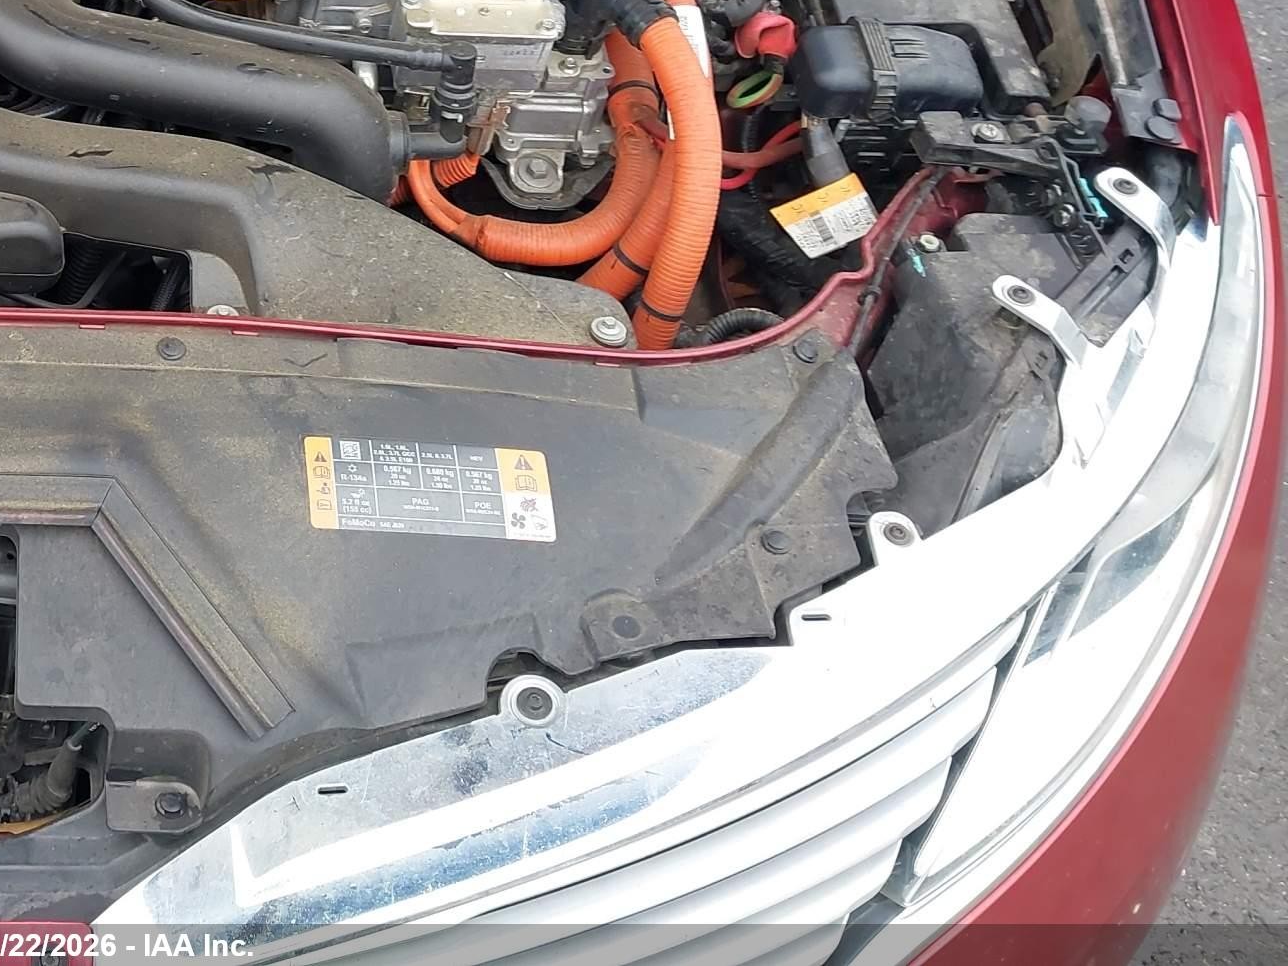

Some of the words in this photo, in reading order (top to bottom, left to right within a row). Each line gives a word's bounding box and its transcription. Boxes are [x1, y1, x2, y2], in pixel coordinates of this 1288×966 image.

[340, 473, 368, 482] R-134a
[411, 497, 429, 505] PAG
[474, 501, 492, 509] POE
[341, 518, 376, 527] FoMoCo
